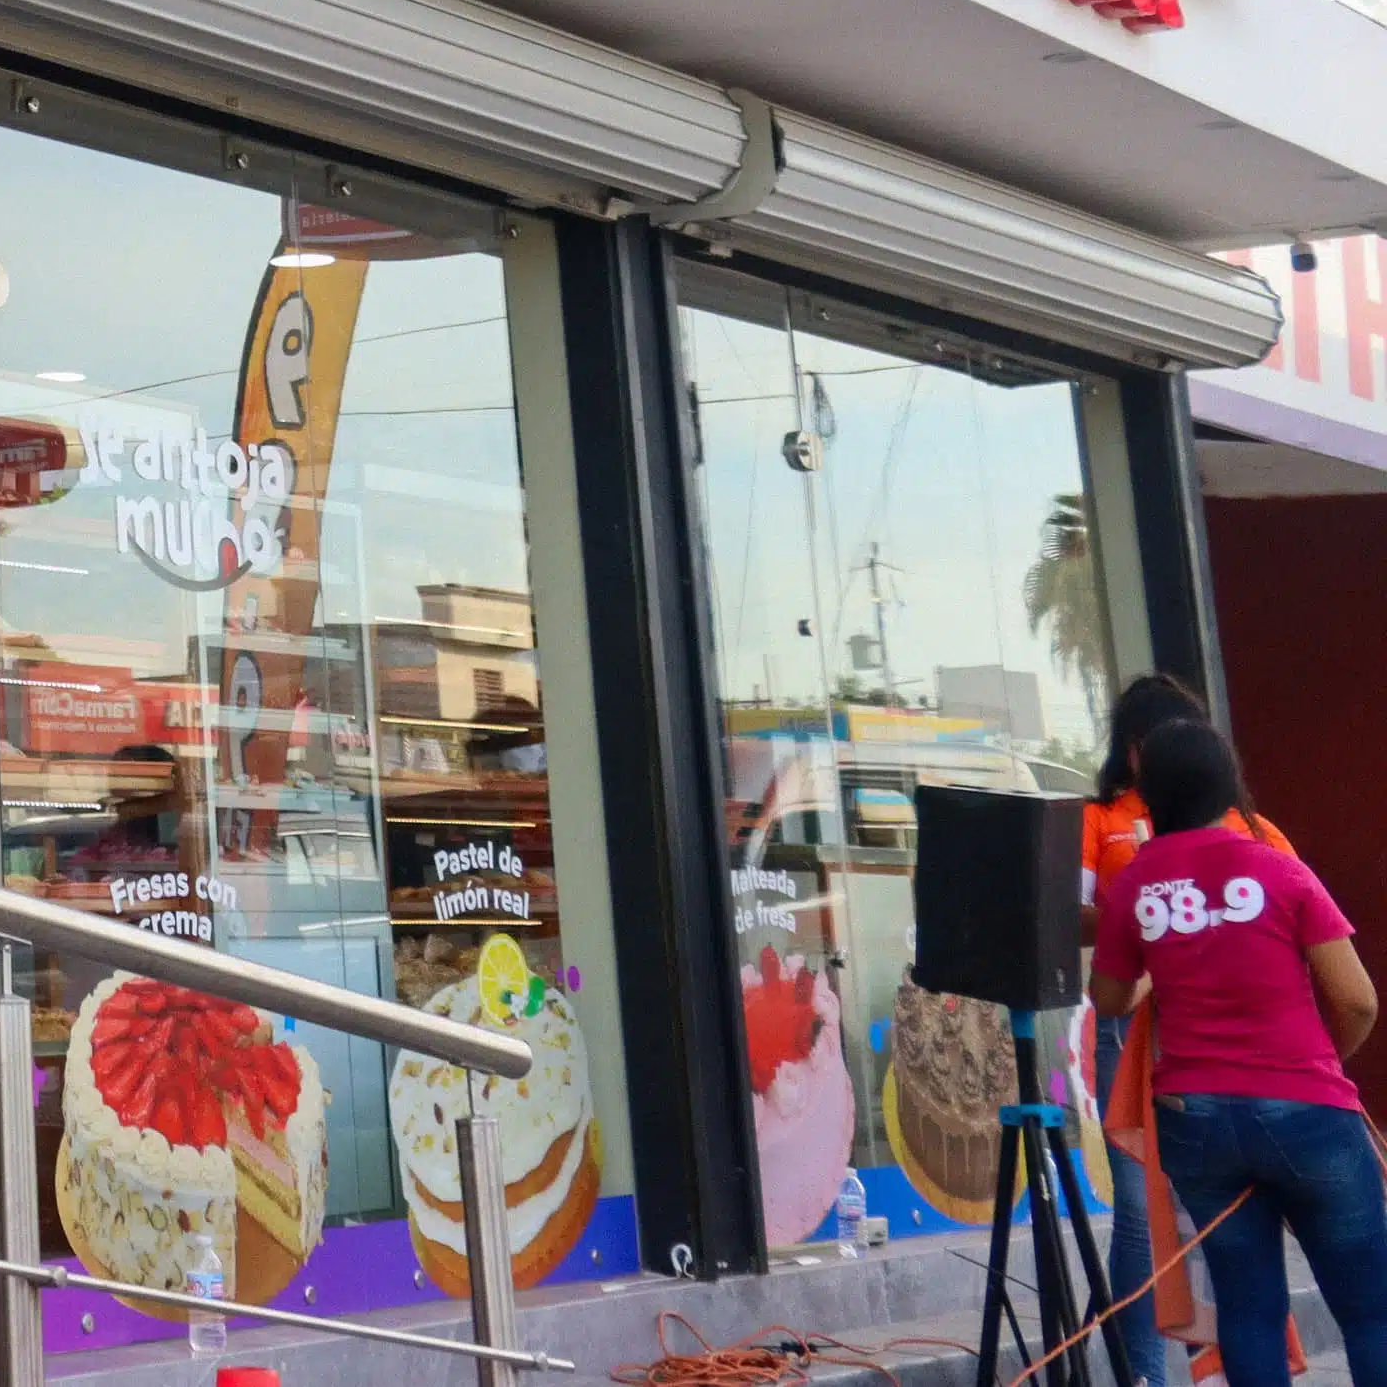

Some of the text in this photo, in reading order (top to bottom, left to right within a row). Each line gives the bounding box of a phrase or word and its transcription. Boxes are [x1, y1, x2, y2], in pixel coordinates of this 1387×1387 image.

[134, 427, 294, 510] antoja
[433, 840, 523, 881] Pastel de
[110, 873, 237, 914] Fresas con
[433, 880, 530, 922] limón real
[1135, 877, 1265, 942] 98.9
[735, 900, 796, 934] de fresa
